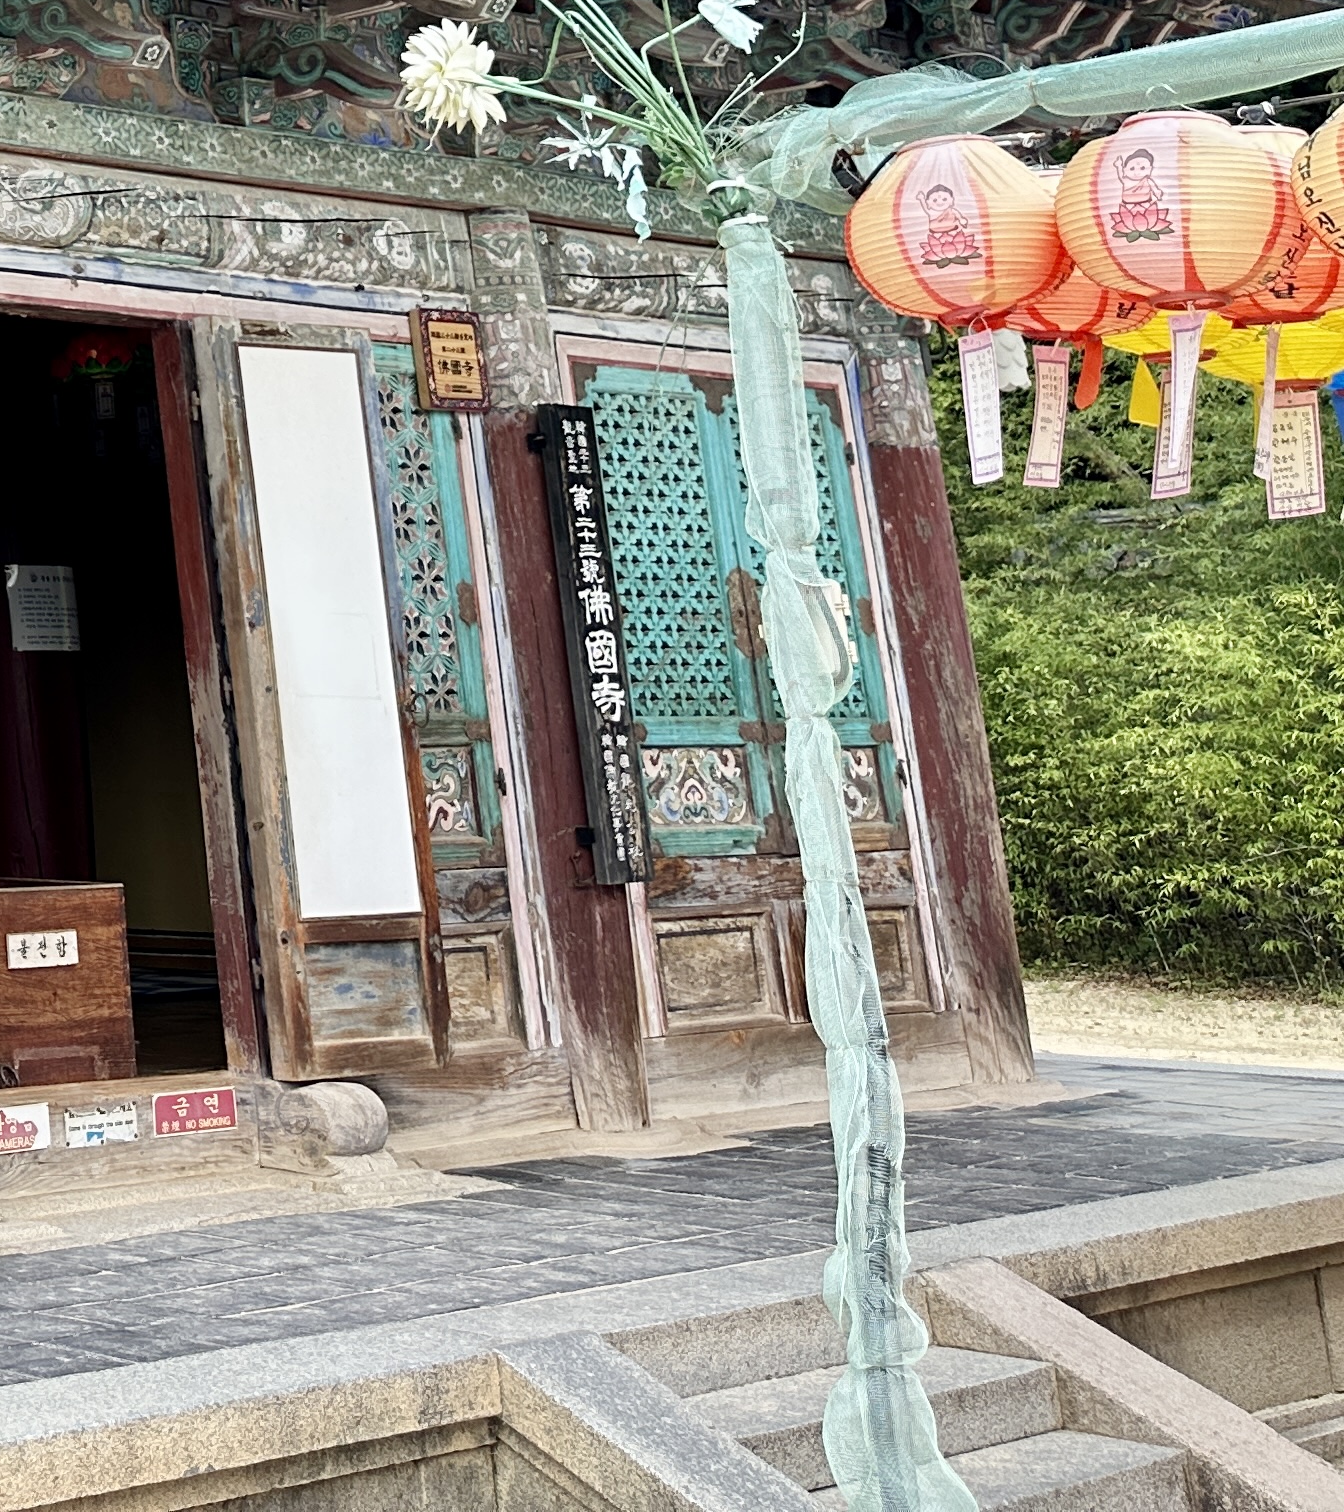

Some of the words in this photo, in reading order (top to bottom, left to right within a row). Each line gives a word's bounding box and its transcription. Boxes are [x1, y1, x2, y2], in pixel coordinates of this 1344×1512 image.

[578, 584, 626, 722] 佛國寺
[17, 935, 68, 960] 불전함
[185, 1119, 197, 1129] NO
[198, 1115, 231, 1129] SMOKING
